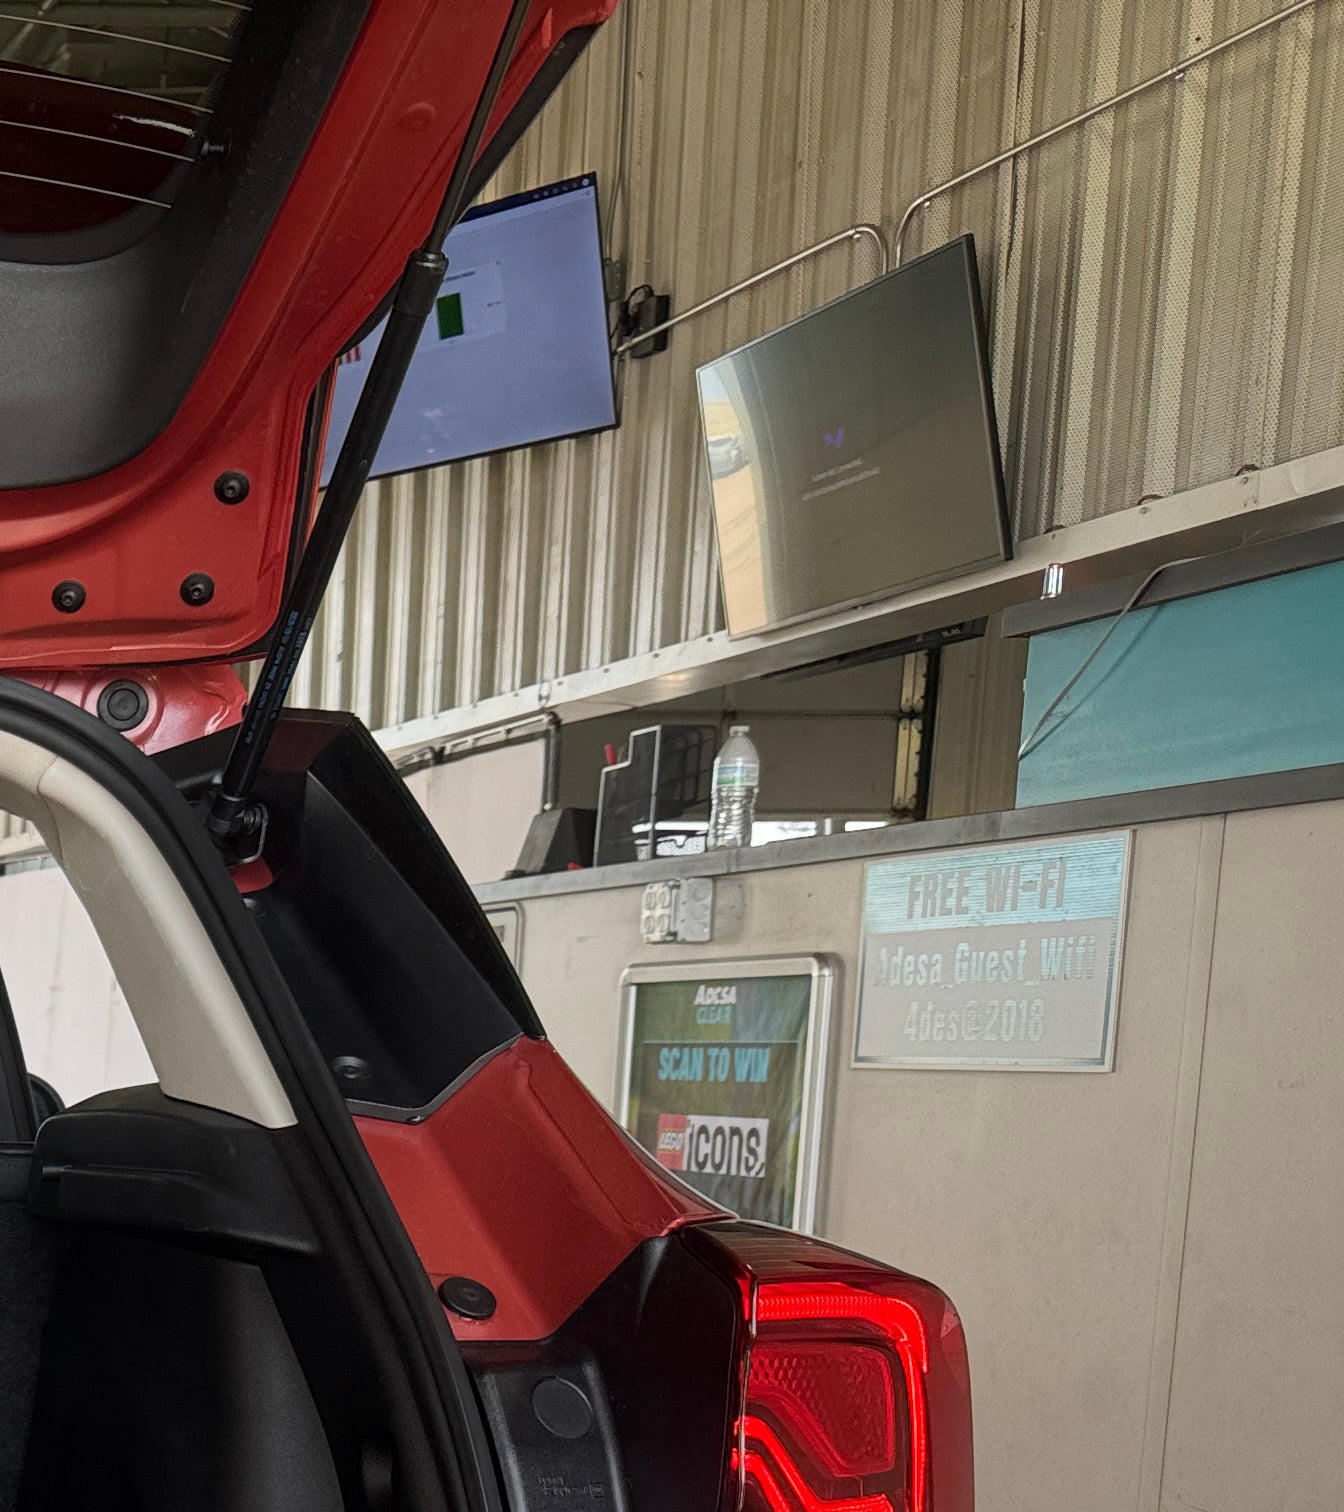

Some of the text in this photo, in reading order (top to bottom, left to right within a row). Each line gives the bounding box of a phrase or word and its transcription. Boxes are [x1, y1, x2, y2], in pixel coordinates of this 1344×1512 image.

[907, 858, 1067, 920] FREE WI-FI
[874, 935, 1097, 989] Adesa_Guest_Wifi
[658, 1047, 770, 1083] SCAN TO WIN
[659, 1131, 683, 1150] LEGO
